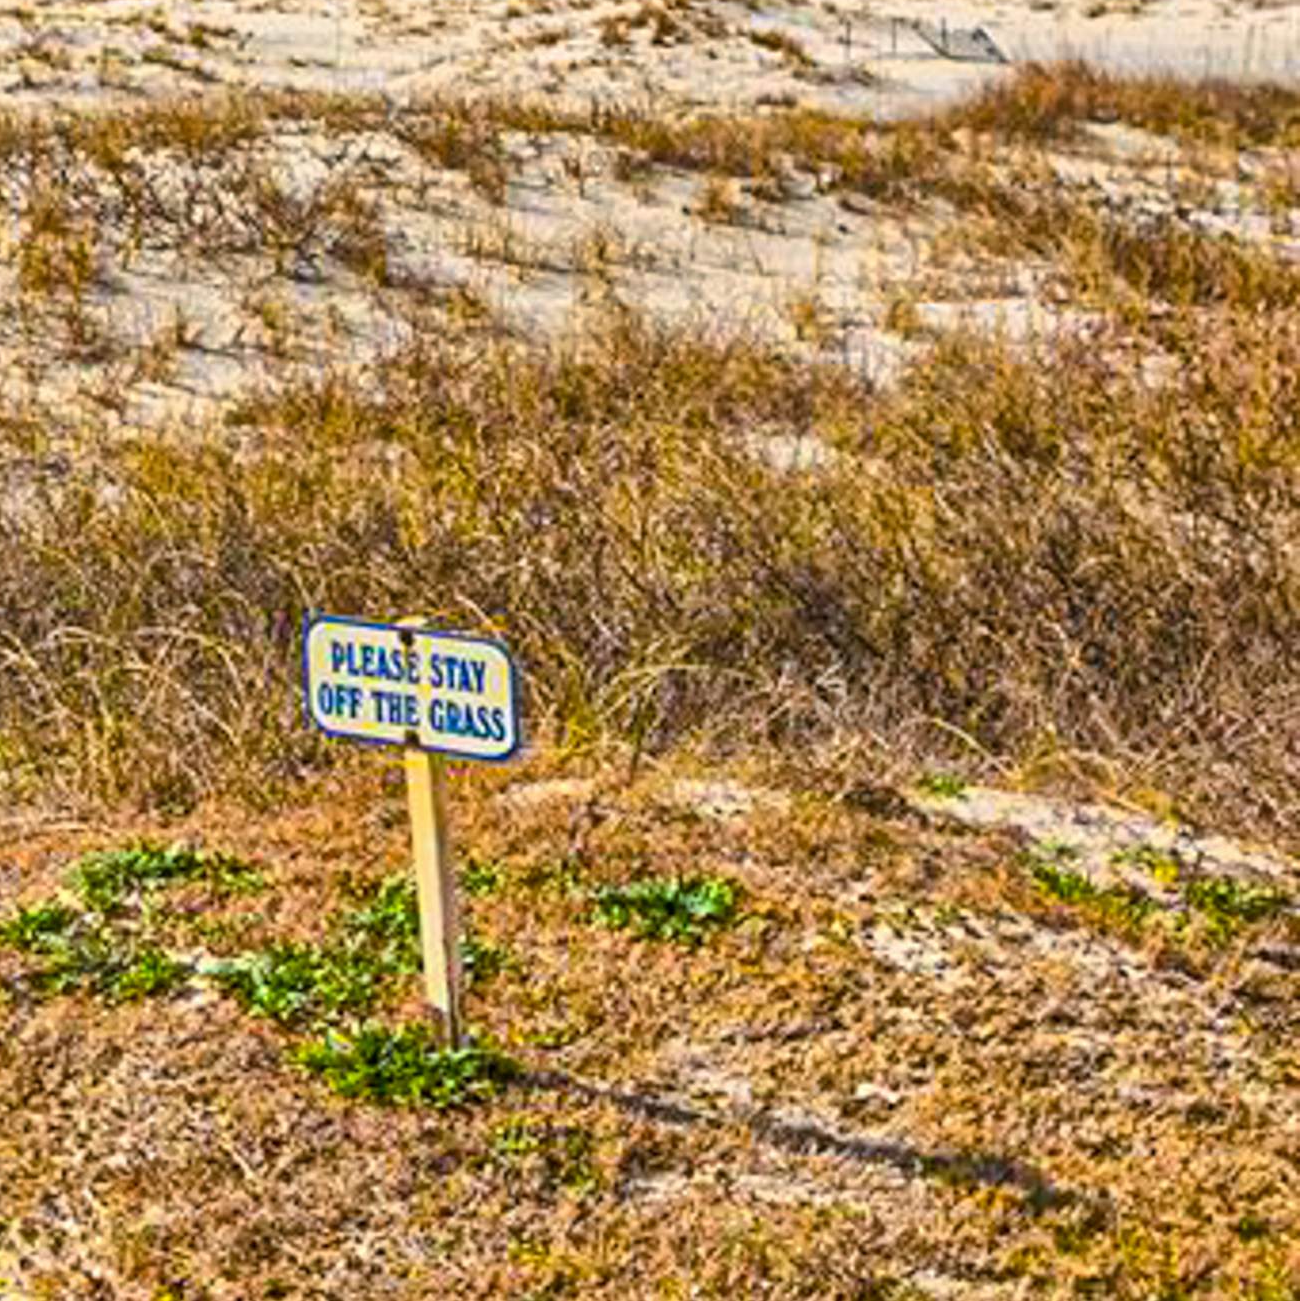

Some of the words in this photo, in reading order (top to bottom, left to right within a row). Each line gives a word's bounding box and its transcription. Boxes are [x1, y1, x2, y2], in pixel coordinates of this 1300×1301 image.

[331, 640, 421, 685] PLEASE
[430, 653, 486, 694] STAY
[318, 682, 363, 719] OFF
[370, 690, 421, 727] THE
[428, 698, 507, 742] GRASS
